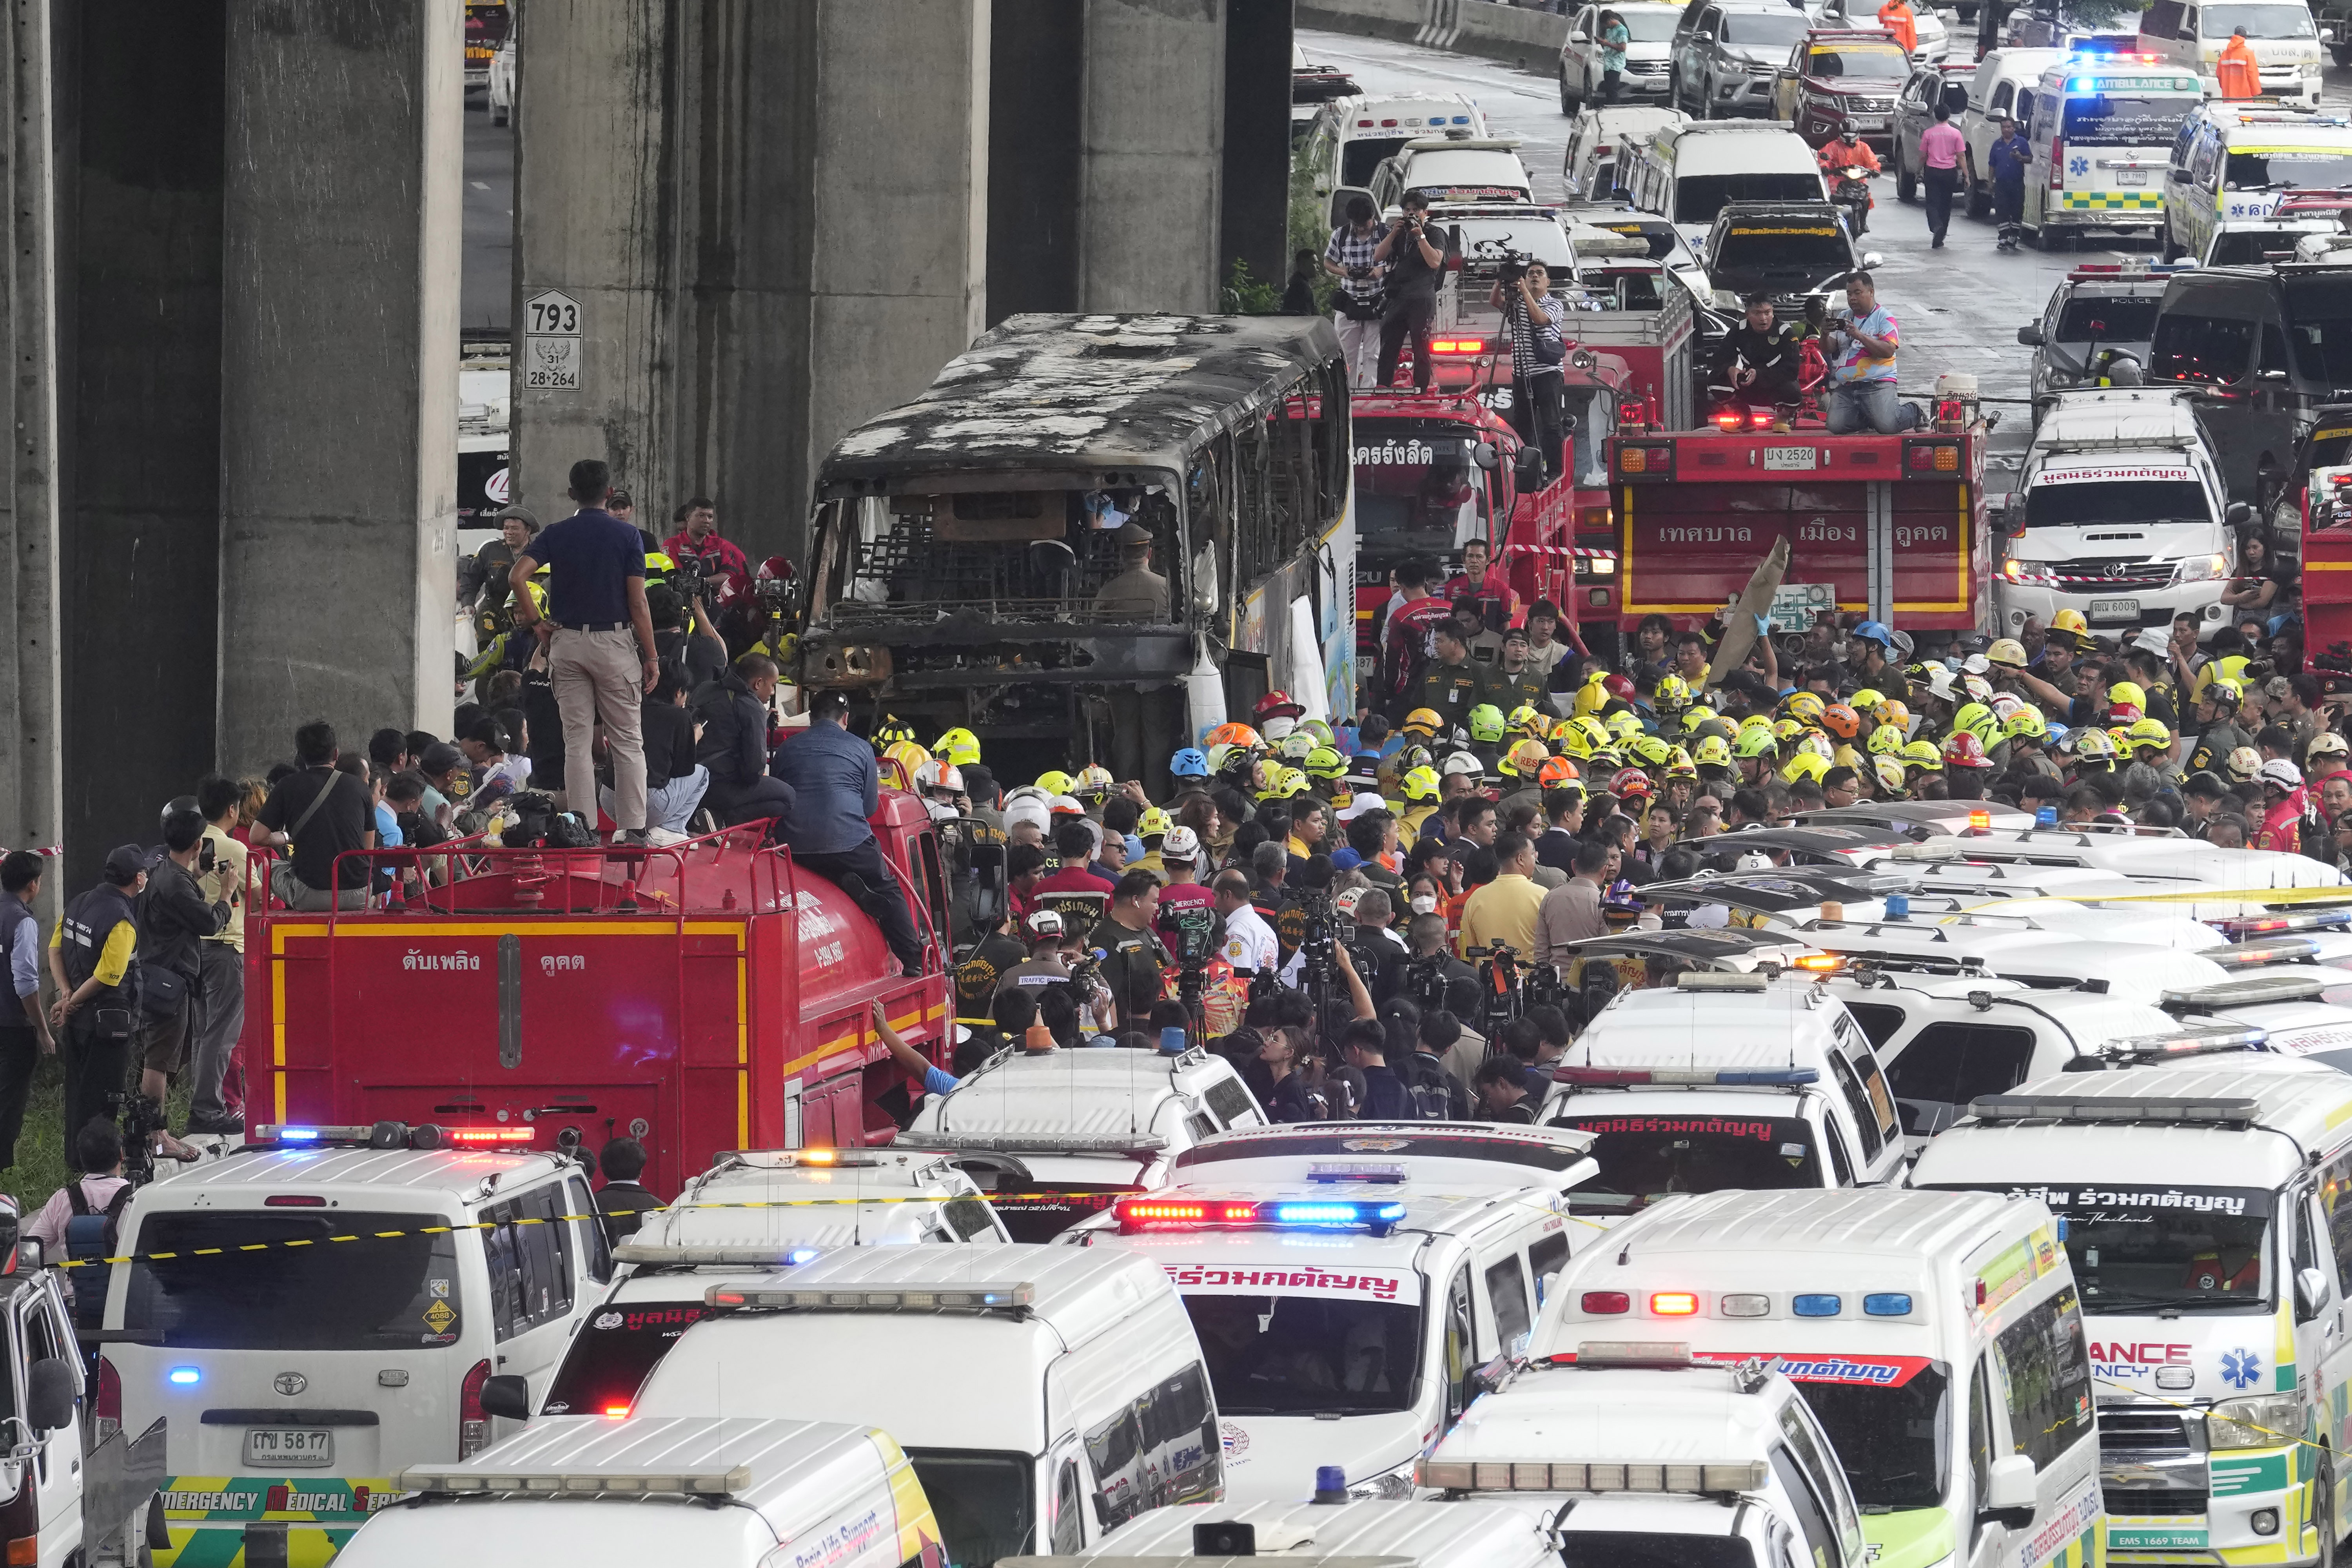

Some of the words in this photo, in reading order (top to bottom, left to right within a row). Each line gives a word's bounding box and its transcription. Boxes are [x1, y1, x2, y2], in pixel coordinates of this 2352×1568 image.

[532, 303, 576, 332] 793
[548, 355, 559, 364] 31
[1787, 448, 1814, 460] 2520
[1659, 526, 1752, 543] เทศบาล
[1800, 517, 1856, 542] เมือง
[1896, 527, 1948, 547] คูคต
[2112, 601, 2136, 612] 6009
[1751, 859, 1759, 868] 5
[402, 949, 480, 971] ดับเพลิง
[541, 954, 585, 977] คูคต
[1578, 1118, 1772, 1142] มลนิธิร่วมกตัญญู
[2078, 1188, 2246, 1215] ร่วมกตัญญู
[2086, 1212, 2154, 1226] Thailand
[284, 1432, 327, 1450] 5817
[160, 1490, 259, 1512] MERGENCY
[265, 1485, 347, 1512] MEDICAL
